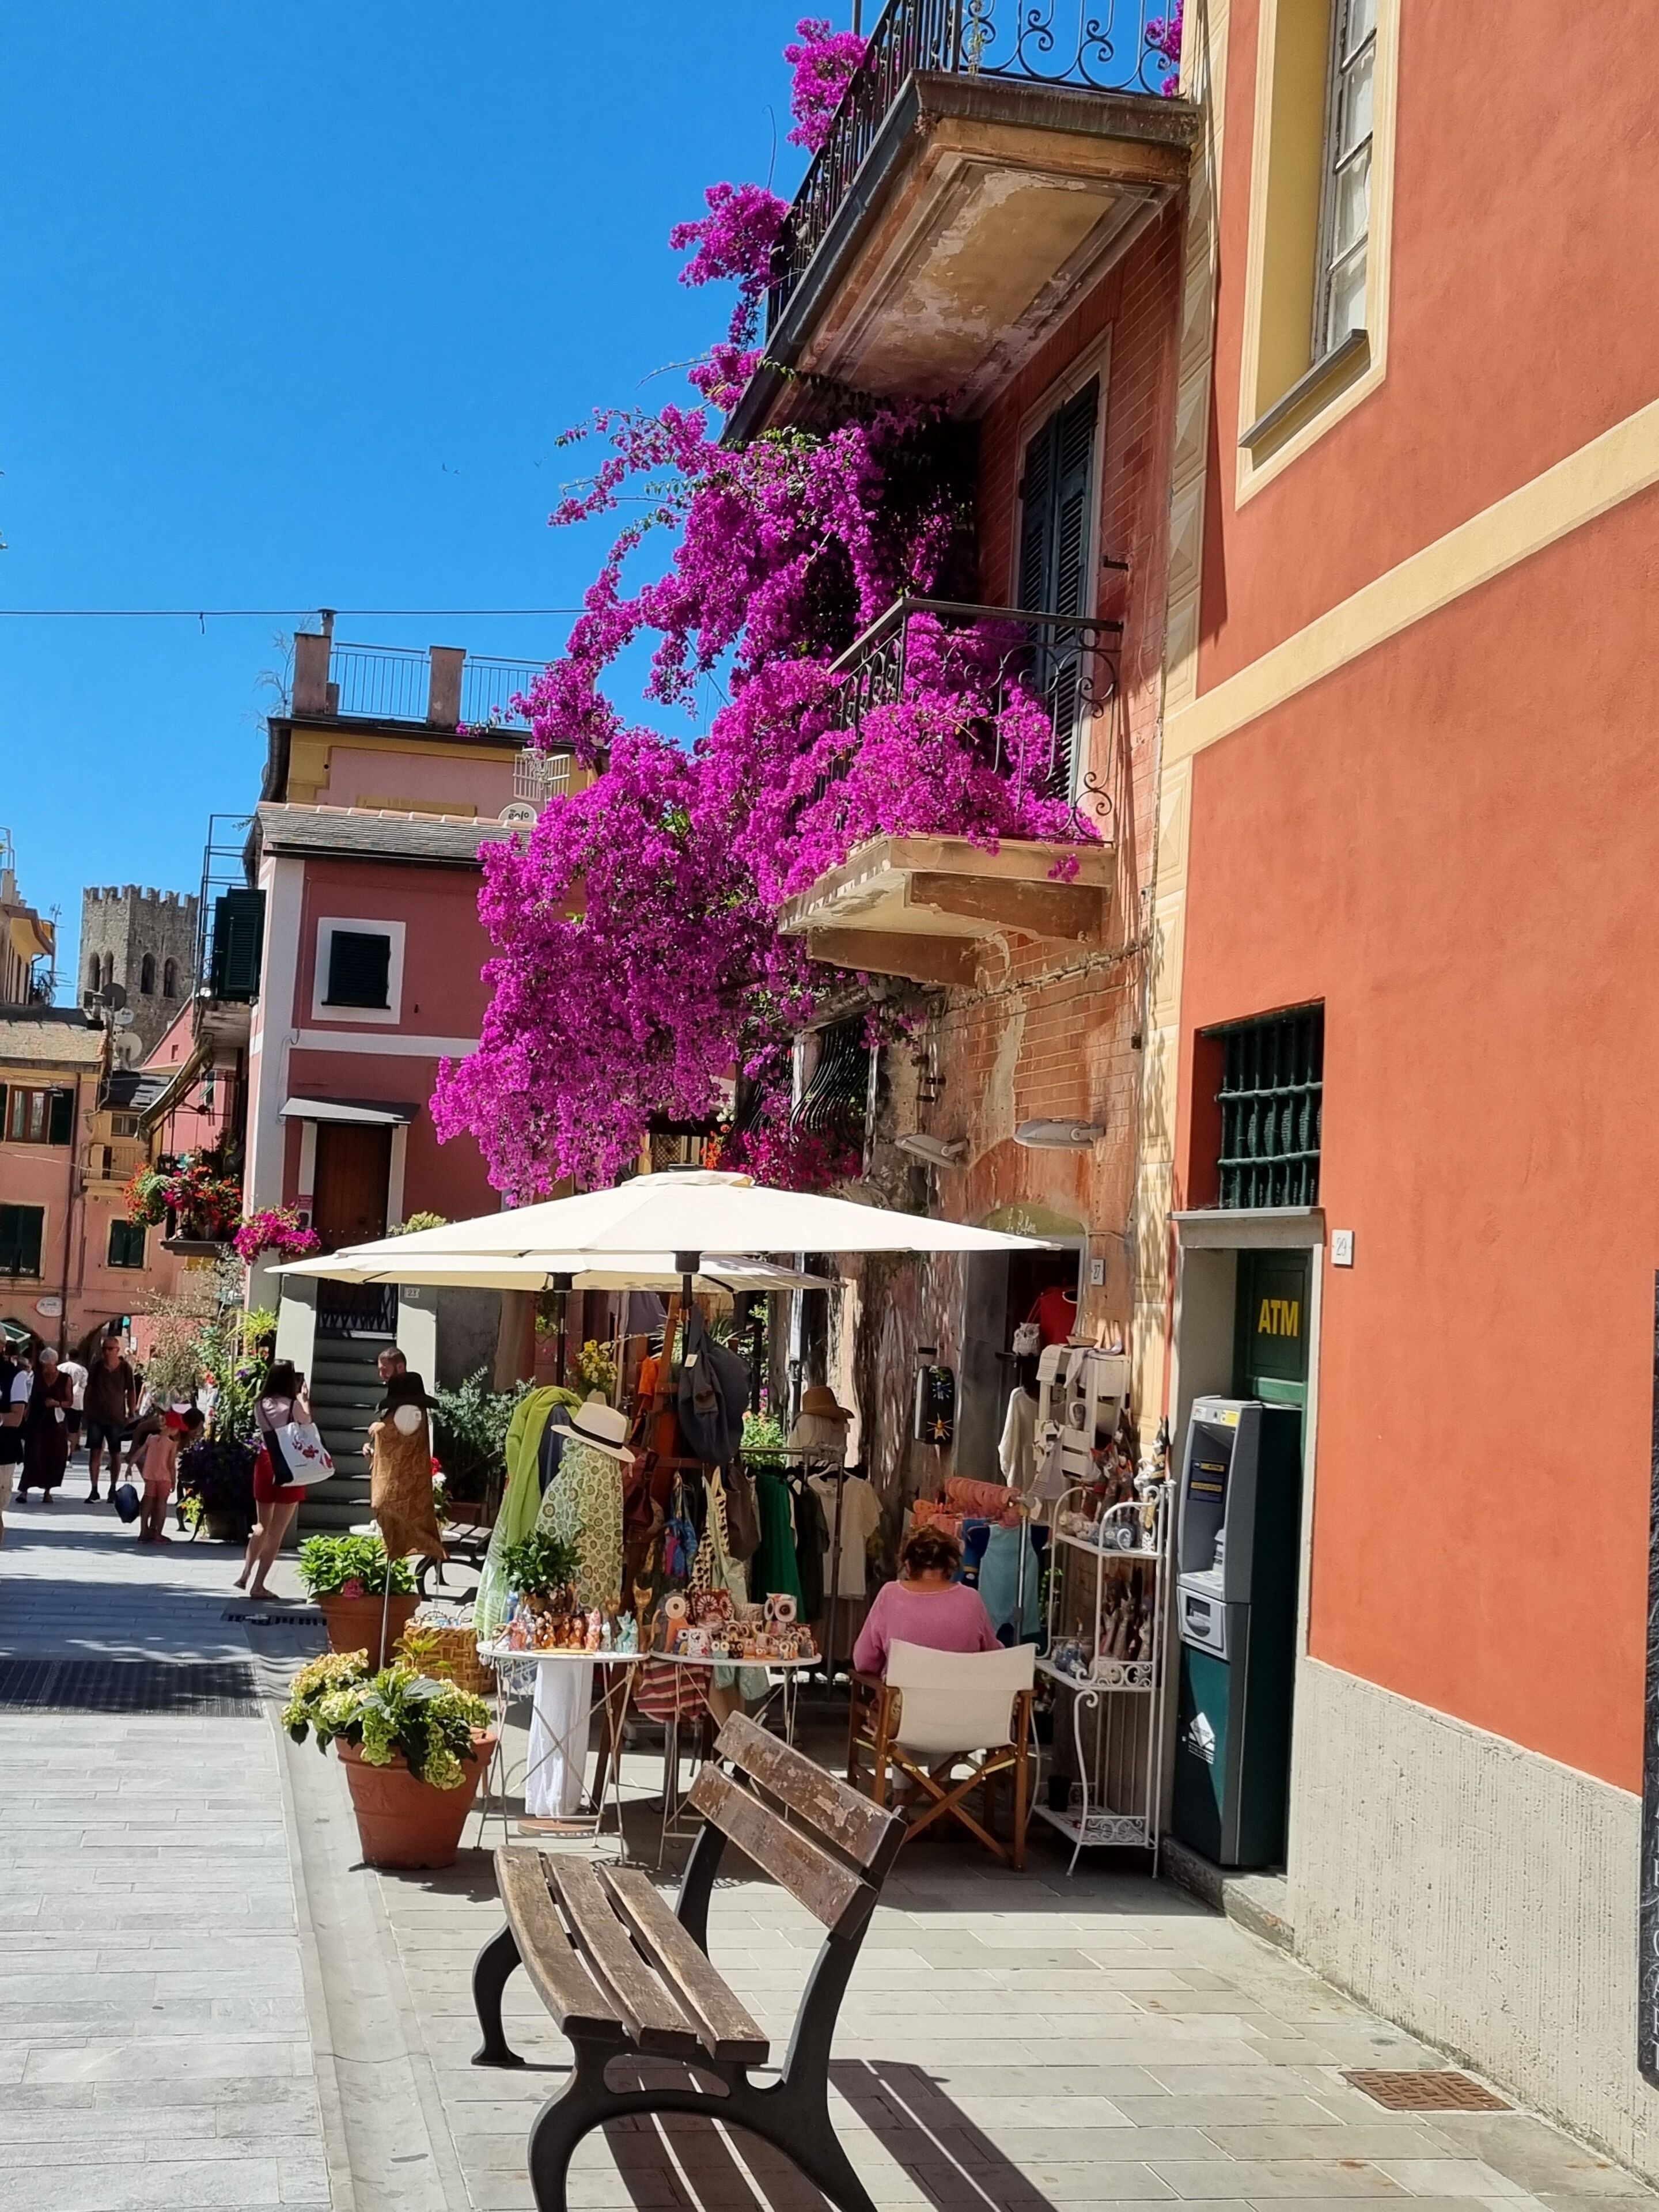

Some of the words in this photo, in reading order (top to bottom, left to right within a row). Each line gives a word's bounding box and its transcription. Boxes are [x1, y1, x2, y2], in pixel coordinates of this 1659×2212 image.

[1336, 1237, 1347, 1256] 29
[1093, 1264, 1101, 1279] 27
[1257, 1299, 1298, 1337] ATM
